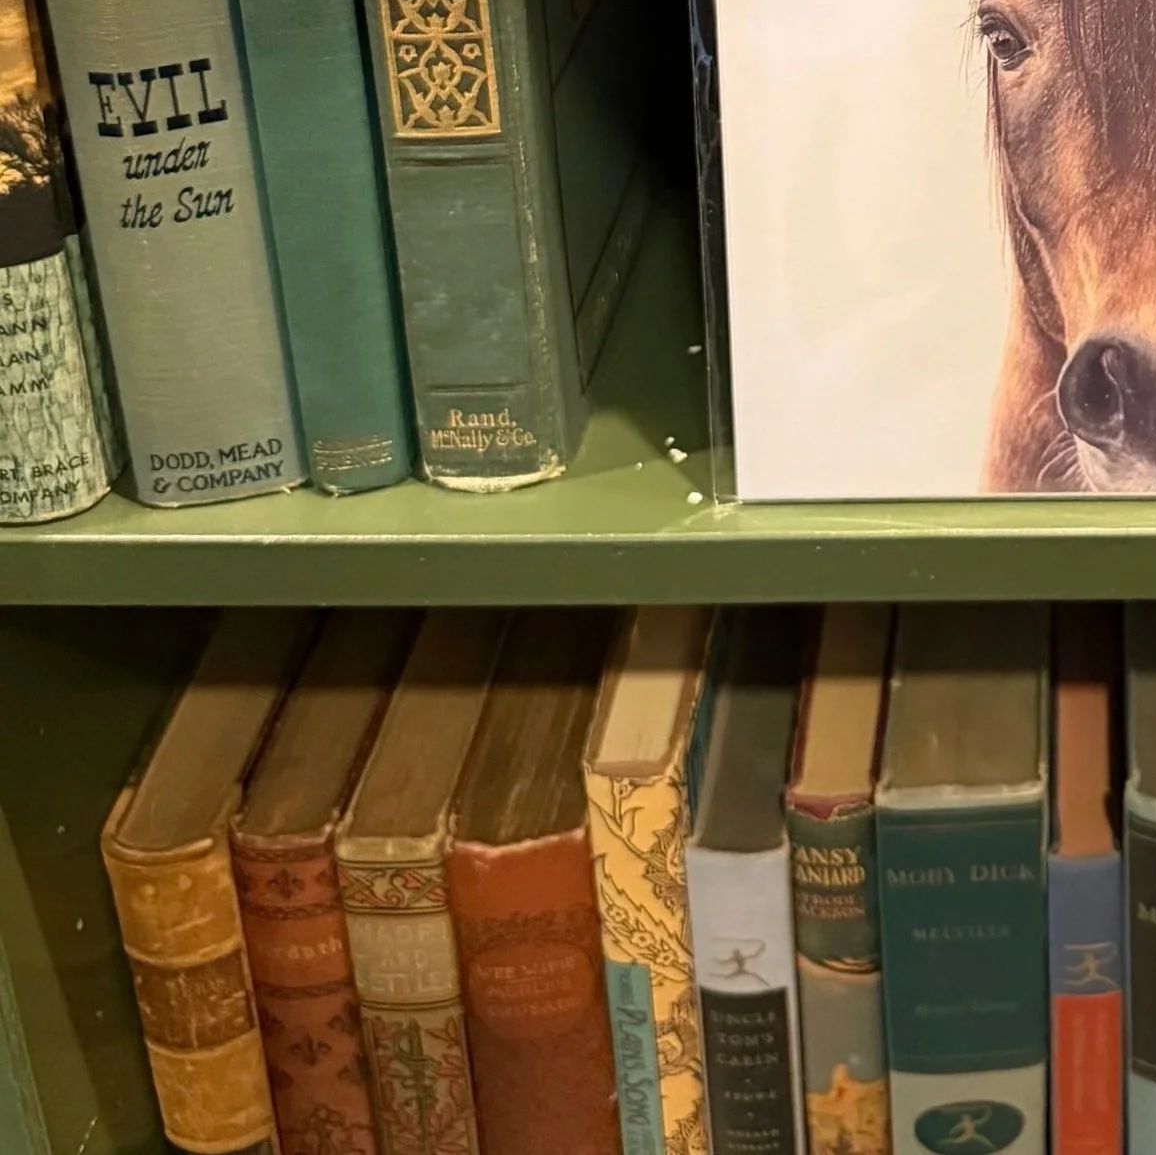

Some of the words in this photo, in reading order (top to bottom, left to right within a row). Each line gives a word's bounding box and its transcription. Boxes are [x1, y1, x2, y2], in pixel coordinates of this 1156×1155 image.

[88, 57, 229, 138] EVIL
[123, 136, 211, 180] under
[120, 193, 164, 229] the
[173, 186, 236, 223] Sun
[32, 451, 90, 478] BRACE
[150, 450, 216, 472] DODD,
[219, 438, 283, 463] MEAD
[153, 477, 171, 494] &
[177, 460, 285, 492] COMPANY
[793, 844, 861, 865] ANSY
[886, 866, 956, 887] MOBY
[970, 863, 1035, 883] DICK
